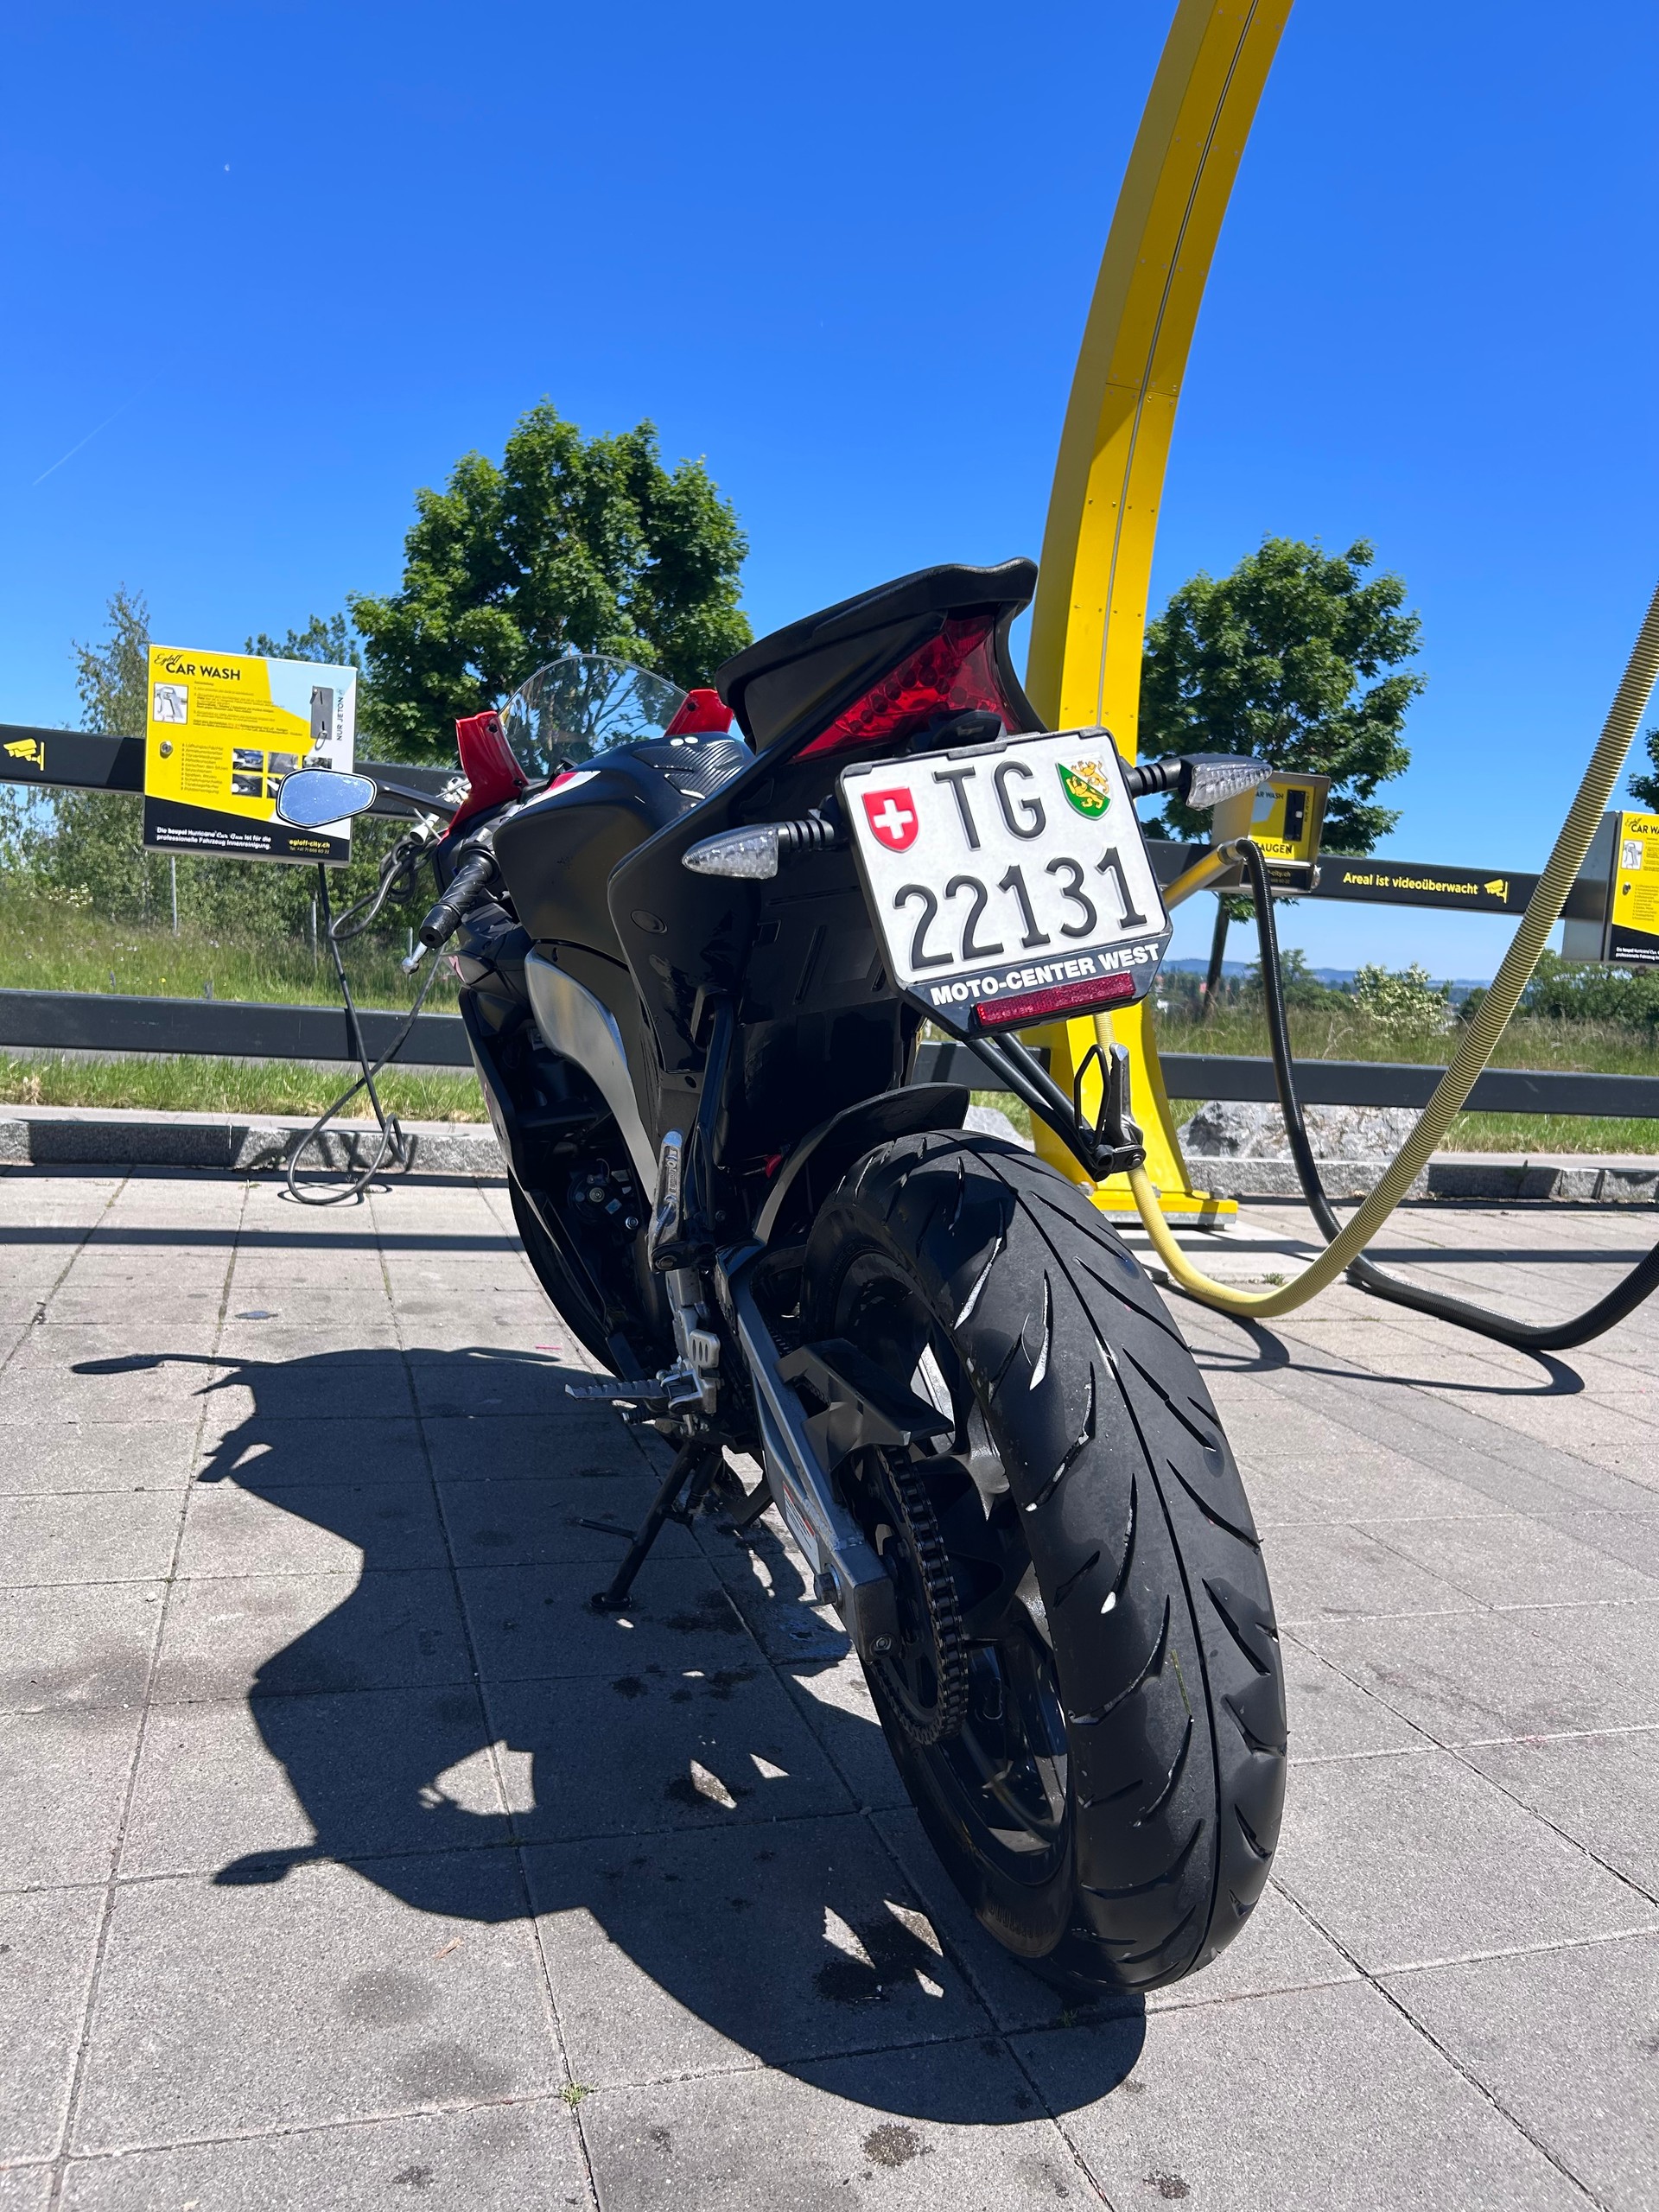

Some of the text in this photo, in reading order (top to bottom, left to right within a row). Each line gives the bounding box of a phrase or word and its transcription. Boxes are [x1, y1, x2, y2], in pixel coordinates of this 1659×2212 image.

[166, 662, 240, 681] CAR WASH
[933, 759, 1046, 849] TG
[1631, 823, 1649, 834] CAR
[1260, 842, 1293, 855] AUGEN
[1343, 872, 1478, 895] Areal ist videoüberwacht
[893, 846, 1147, 970] 22131
[930, 944, 1160, 1006] MOTO-CENTER WEST
